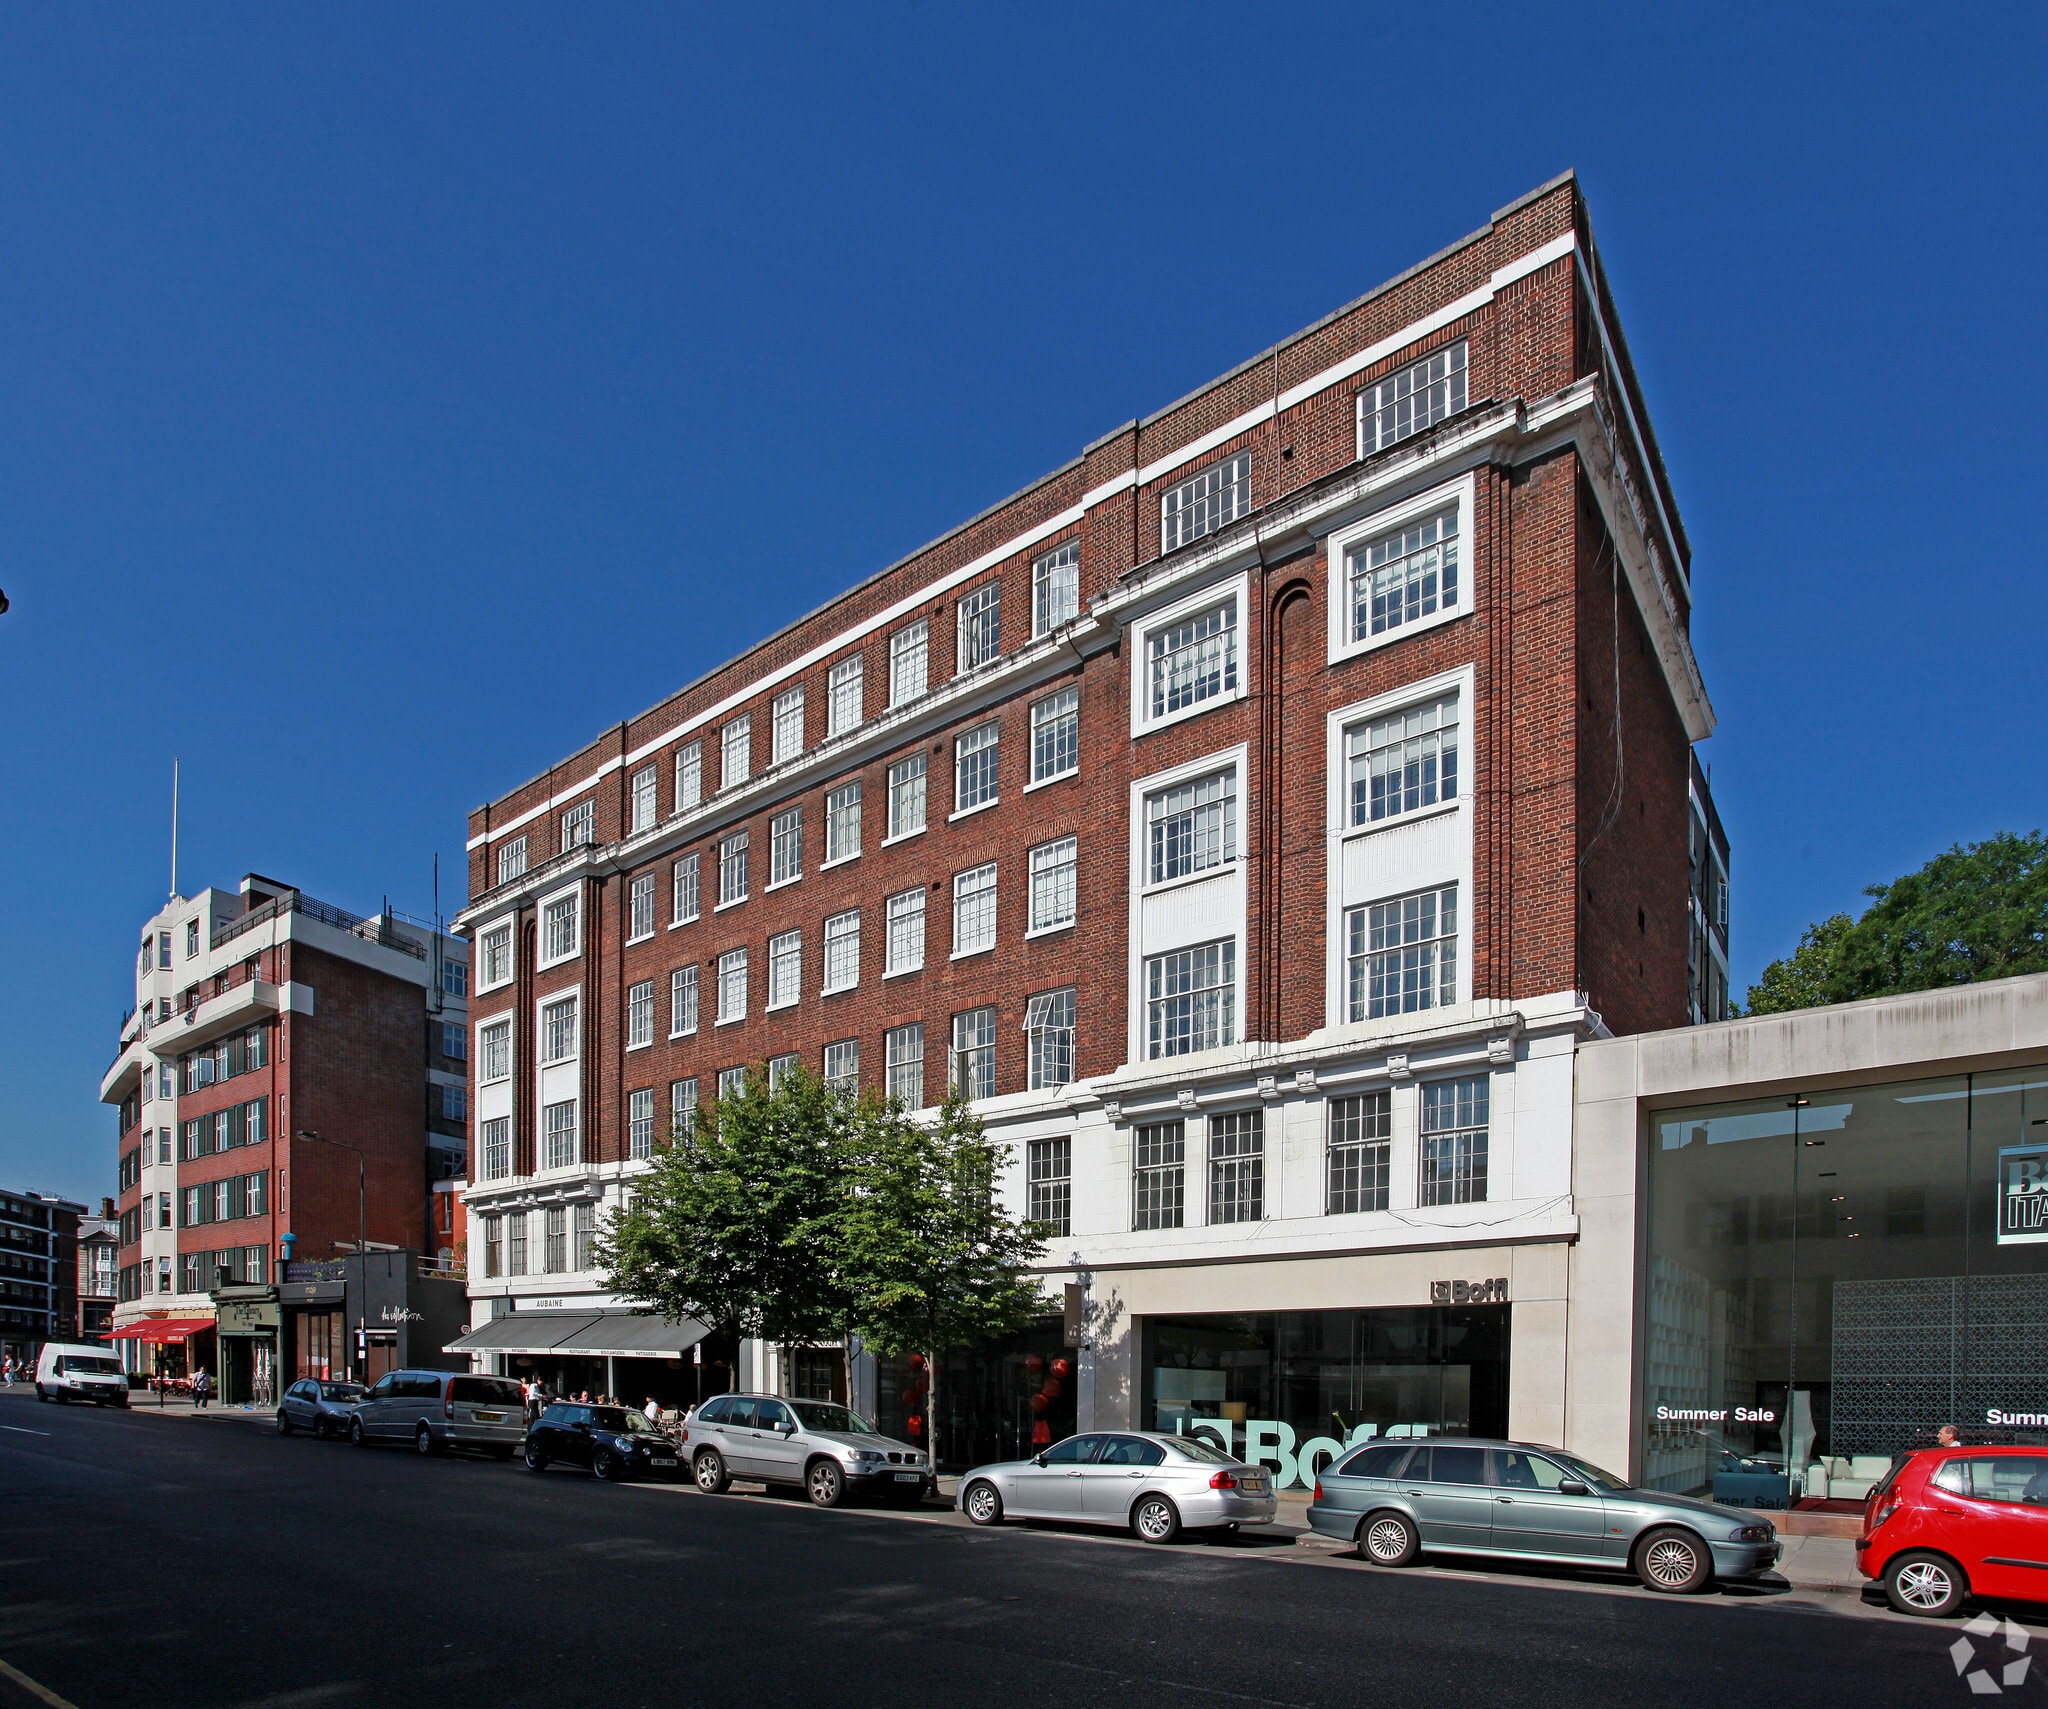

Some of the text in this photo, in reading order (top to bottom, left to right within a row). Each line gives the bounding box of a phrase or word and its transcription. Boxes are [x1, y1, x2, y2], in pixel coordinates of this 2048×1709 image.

[536, 1299, 563, 1308] AUBAINE
[1656, 1406, 1775, 1422] Summer Sale
